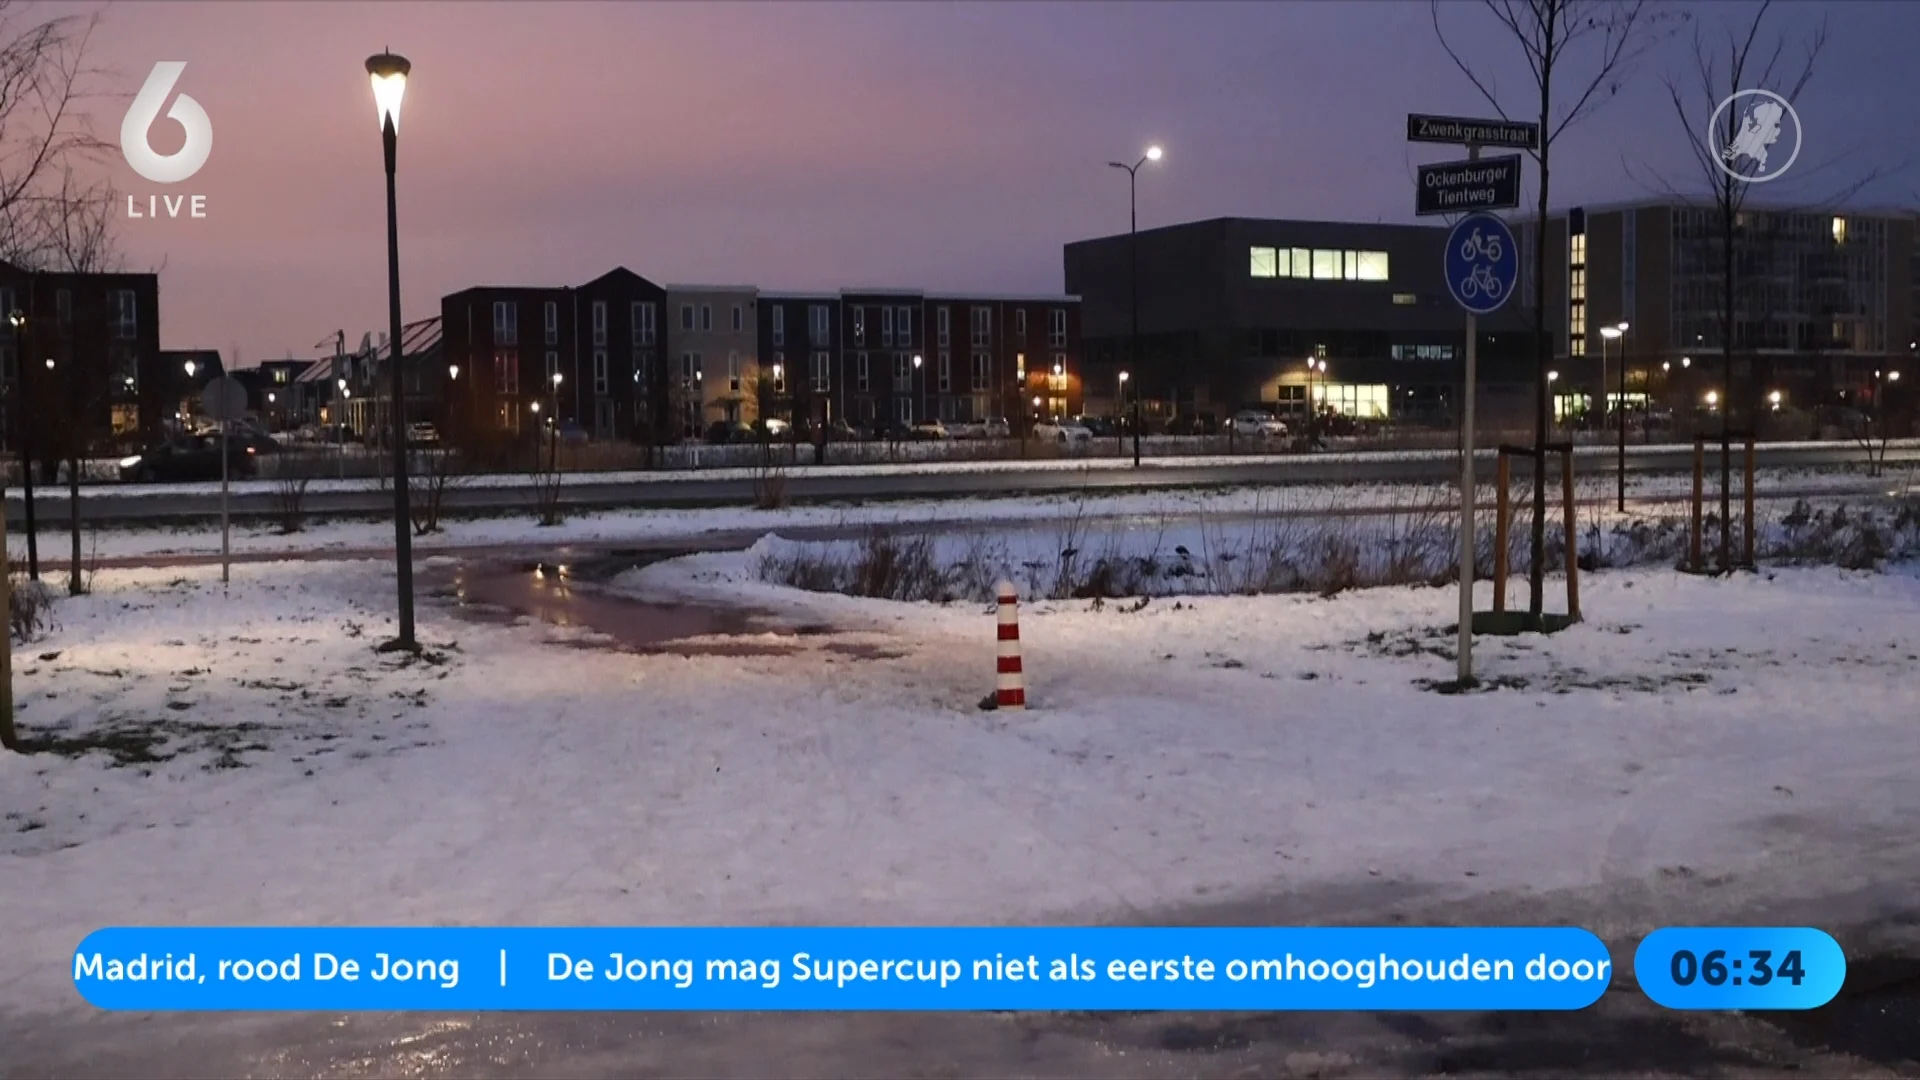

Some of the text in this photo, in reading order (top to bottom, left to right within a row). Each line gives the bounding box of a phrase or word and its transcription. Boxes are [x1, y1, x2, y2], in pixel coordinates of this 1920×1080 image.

[1419, 120, 1529, 141] Zwenkgrasstraat
[1426, 167, 1508, 188] Ockenburger
[1438, 188, 1495, 205] Tientweg
